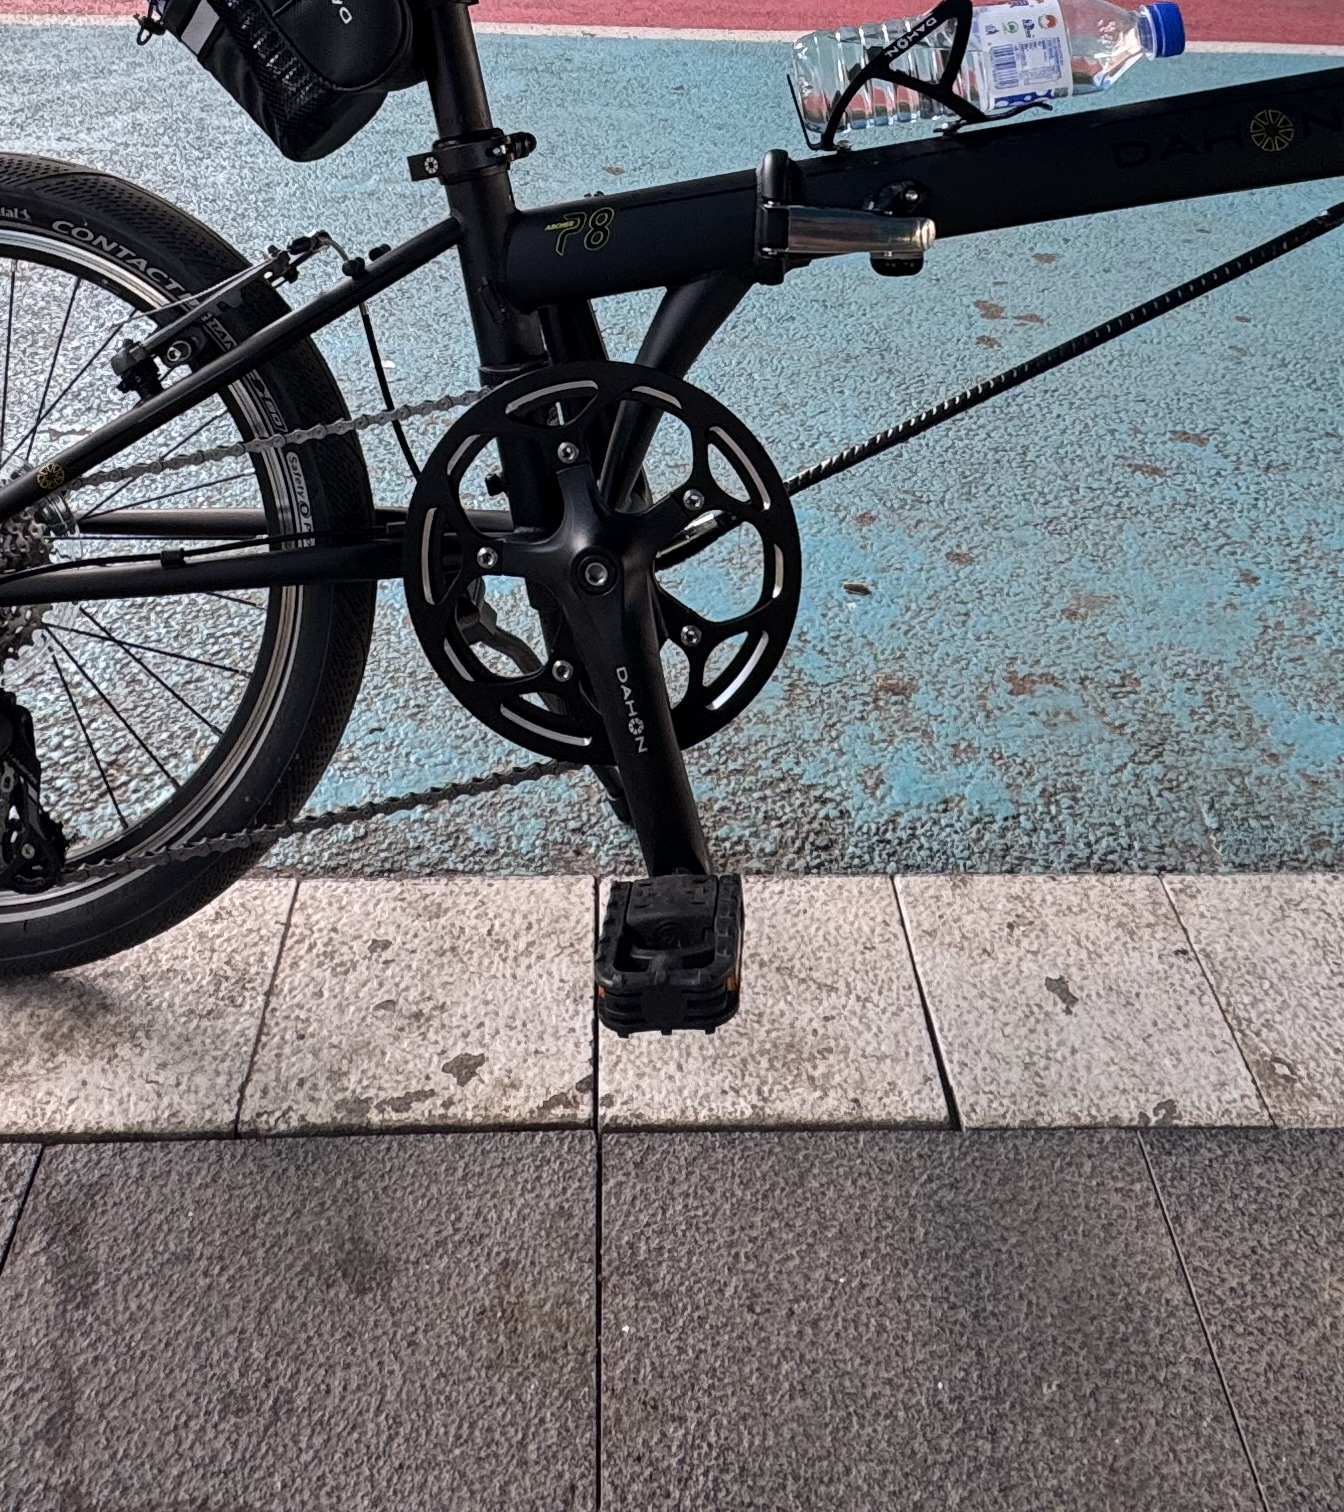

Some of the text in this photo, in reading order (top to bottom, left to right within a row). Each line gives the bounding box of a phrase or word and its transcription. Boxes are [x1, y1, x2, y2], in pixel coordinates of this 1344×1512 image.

[884, 16, 938, 58] DAHON
[52, 219, 186, 294] CONTACT
[555, 206, 615, 257] P8
[288, 452, 307, 499] Safety
[616, 666, 649, 753] DAHON
